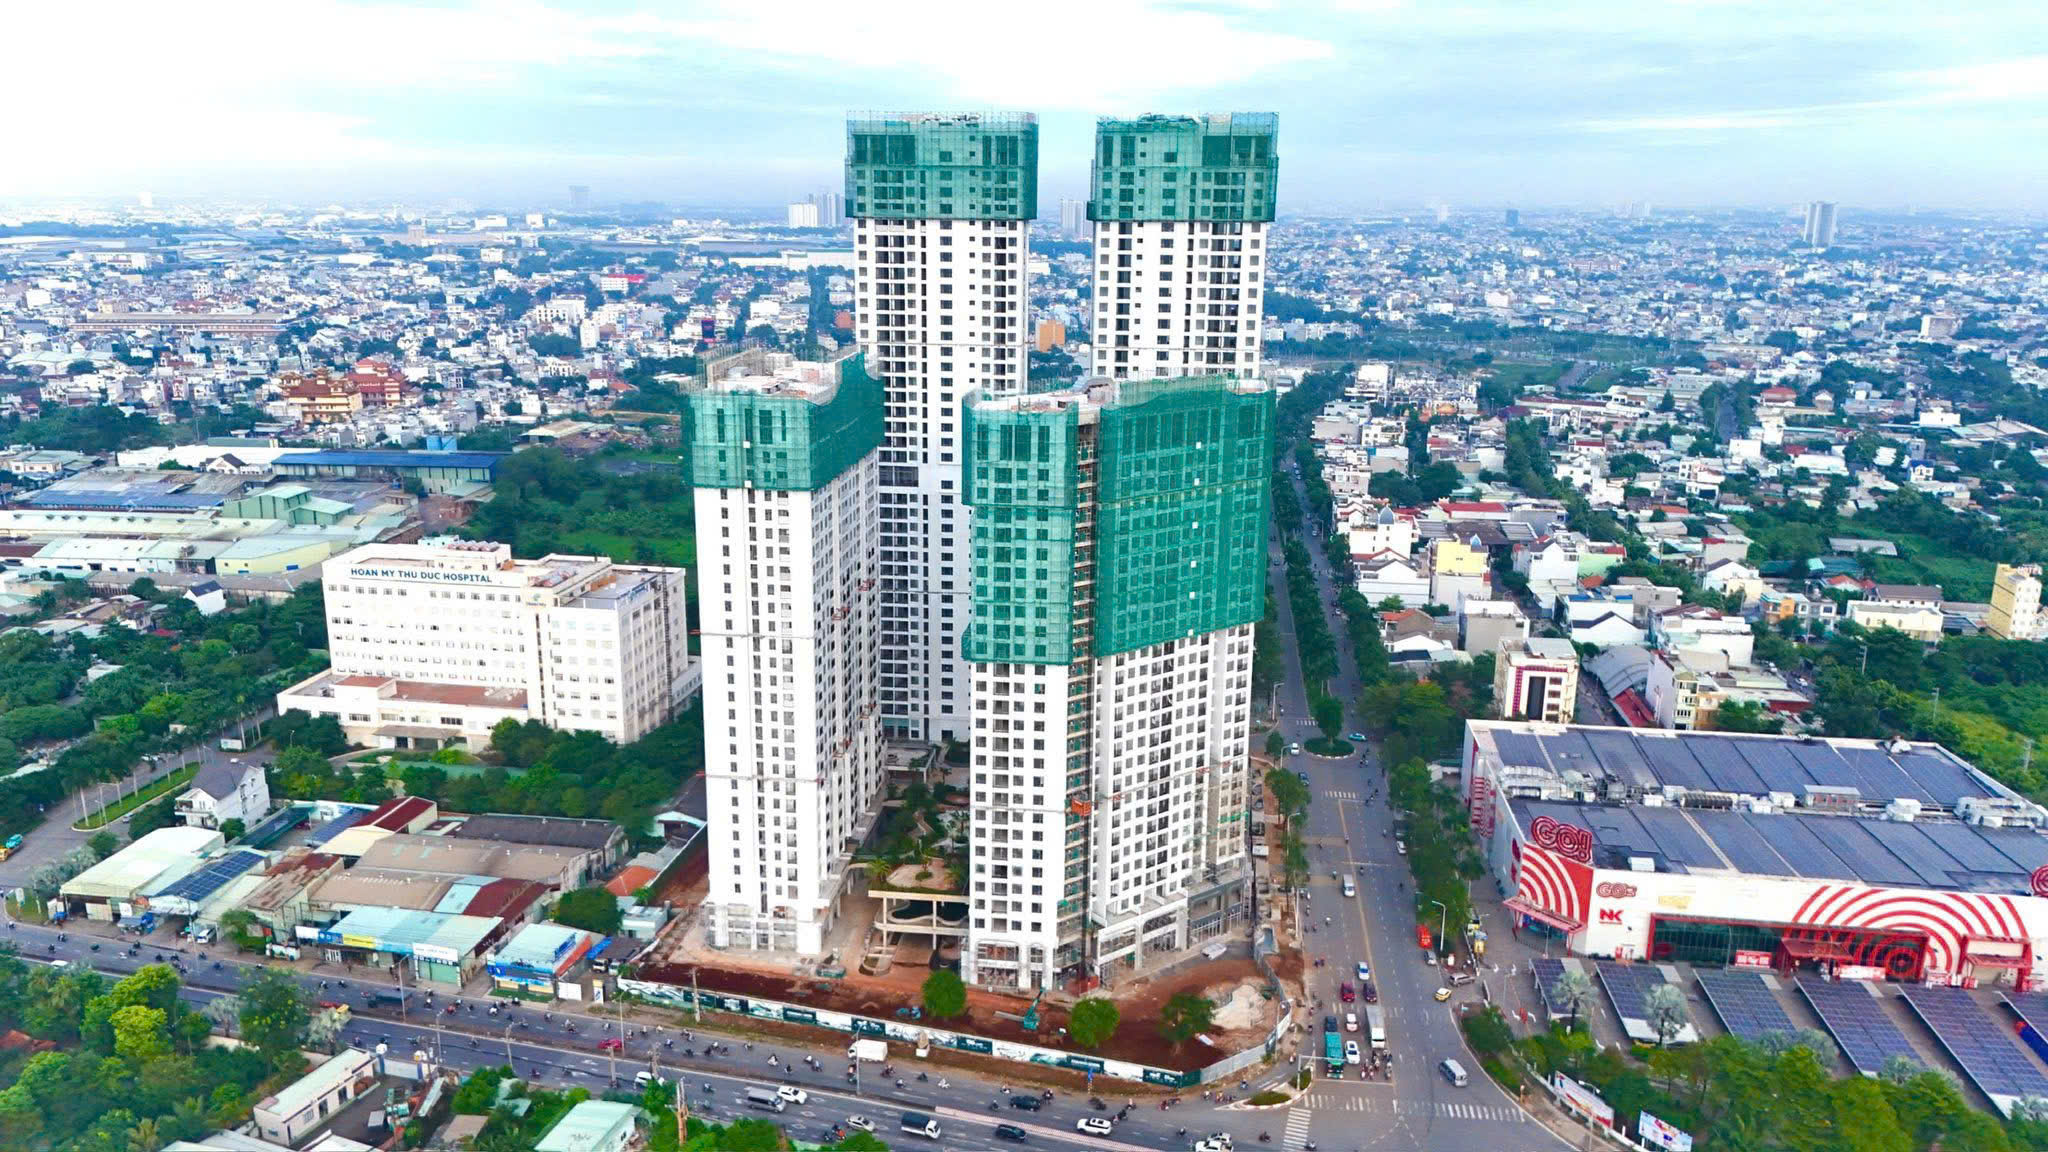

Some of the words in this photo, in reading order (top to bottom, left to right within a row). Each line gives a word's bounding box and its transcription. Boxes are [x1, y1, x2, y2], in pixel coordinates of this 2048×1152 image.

[351, 568, 378, 577] HOAN
[398, 570, 417, 579] THU
[420, 571, 440, 580] DUC
[443, 572, 492, 583] HOSPITAL
[1531, 816, 1593, 863] GO!
[1600, 909, 1623, 921] NK
